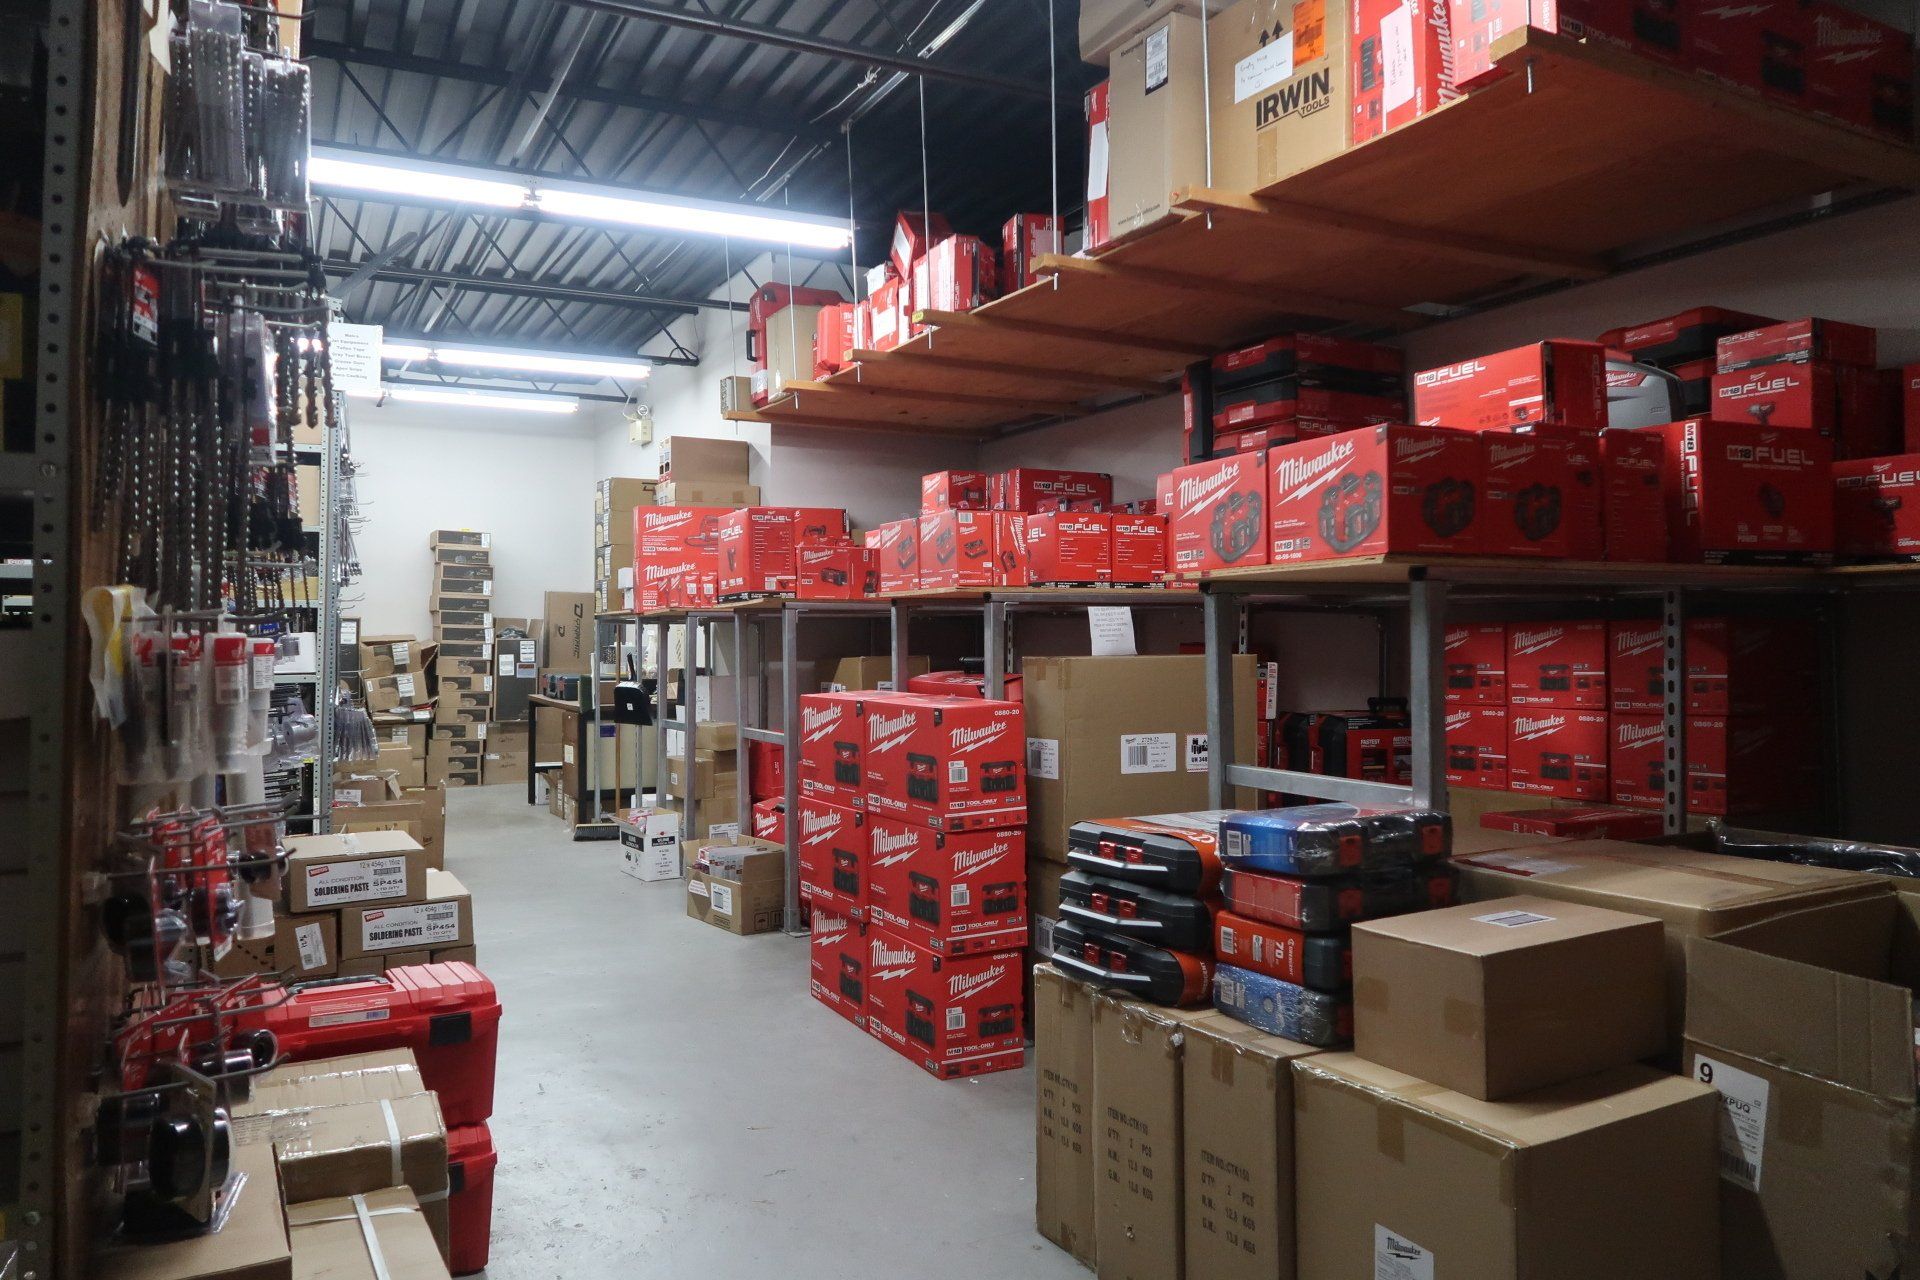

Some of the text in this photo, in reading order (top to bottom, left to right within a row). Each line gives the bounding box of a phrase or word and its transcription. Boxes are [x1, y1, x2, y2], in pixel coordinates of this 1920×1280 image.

[1256, 67, 1330, 128] IRWIN
[1301, 97, 1330, 116] TOOLS
[1732, 329, 1763, 342] FUEL
[1418, 372, 1435, 385] M18
[1437, 361, 1486, 380] FUEL
[1720, 376, 1801, 397] M18 FUEL
[1394, 435, 1447, 457] Milwaukee
[1490, 443, 1536, 463] Milwaukee
[1756, 447, 1815, 465] FUEL
[1275, 438, 1355, 494] Milwaukee
[1685, 422, 1698, 527] M18 FUEL
[1034, 481, 1097, 494] M18 FUEL
[1177, 461, 1241, 510] Milwaukee
[642, 510, 693, 529] Milwaukee
[1059, 523, 1107, 531] M18 FUEL
[1011, 515, 1026, 555] Milwaukee
[1131, 525, 1162, 533] FUEL
[804, 549, 834, 560] Milwaukee
[1177, 550, 1191, 561] M18
[1276, 541, 1293, 554] M18
[643, 562, 697, 582] Milwaukee
[1513, 627, 1563, 650] Milwaukee
[802, 702, 842, 734] Milwaukee
[1513, 714, 1566, 736] Milwaukee
[867, 710, 917, 744] Milwaukee
[949, 721, 1007, 748] Milwaukee
[803, 779, 835, 795] M18 TOOL-ONLY
[1526, 782, 1554, 791] TOOL-ONLY
[868, 793, 908, 809] M18 TOOL-ONLY
[967, 798, 998, 807] TOOL-ONLY
[755, 813, 778, 830] Milwaukee
[802, 809, 842, 836] Milwaukee
[871, 826, 919, 856] Milwaukee
[997, 830, 1021, 838] 0880-20
[951, 843, 1009, 872] Milwaukee
[314, 883, 369, 897] SOLDERING PASTE
[373, 879, 403, 887] SP454
[801, 881, 833, 899] M18 TOOL-ONLY
[386, 919, 418, 928] CONDITION
[813, 910, 848, 935] Milwaukee
[871, 905, 910, 927] M18 TOOL-ONLY
[426, 923, 455, 932] SP454
[968, 920, 998, 930] TOOL-ONLY
[370, 927, 422, 941] SOLDERING PASTE
[870, 938, 917, 968] Milwaukee
[1275, 941, 1284, 959] 70
[947, 965, 1005, 995] Milwaukee
[812, 979, 840, 1002] M18 TOOL-ONLY
[870, 1016, 906, 1044] M18 TOOL-ONLY
[947, 1042, 994, 1056] M18 TOOL-ONLY
[1043, 1069, 1054, 1081] ITEM
[1700, 1062, 1713, 1084] 9
[1072, 1102, 1081, 1114] PCS
[1108, 1107, 1119, 1121] ITEM
[1073, 1121, 1081, 1135] KGS
[1073, 1141, 1081, 1154] KGS
[1142, 1144, 1152, 1158] PCS
[1201, 1150, 1215, 1165] ITEM
[1143, 1166, 1152, 1180] KGS
[1143, 1187, 1153, 1202] KGS
[1242, 1192, 1254, 1208] PCS
[1243, 1216, 1256, 1232] KGS
[1243, 1240, 1256, 1255] KGS
[1386, 1236, 1421, 1256] Milwaukee
